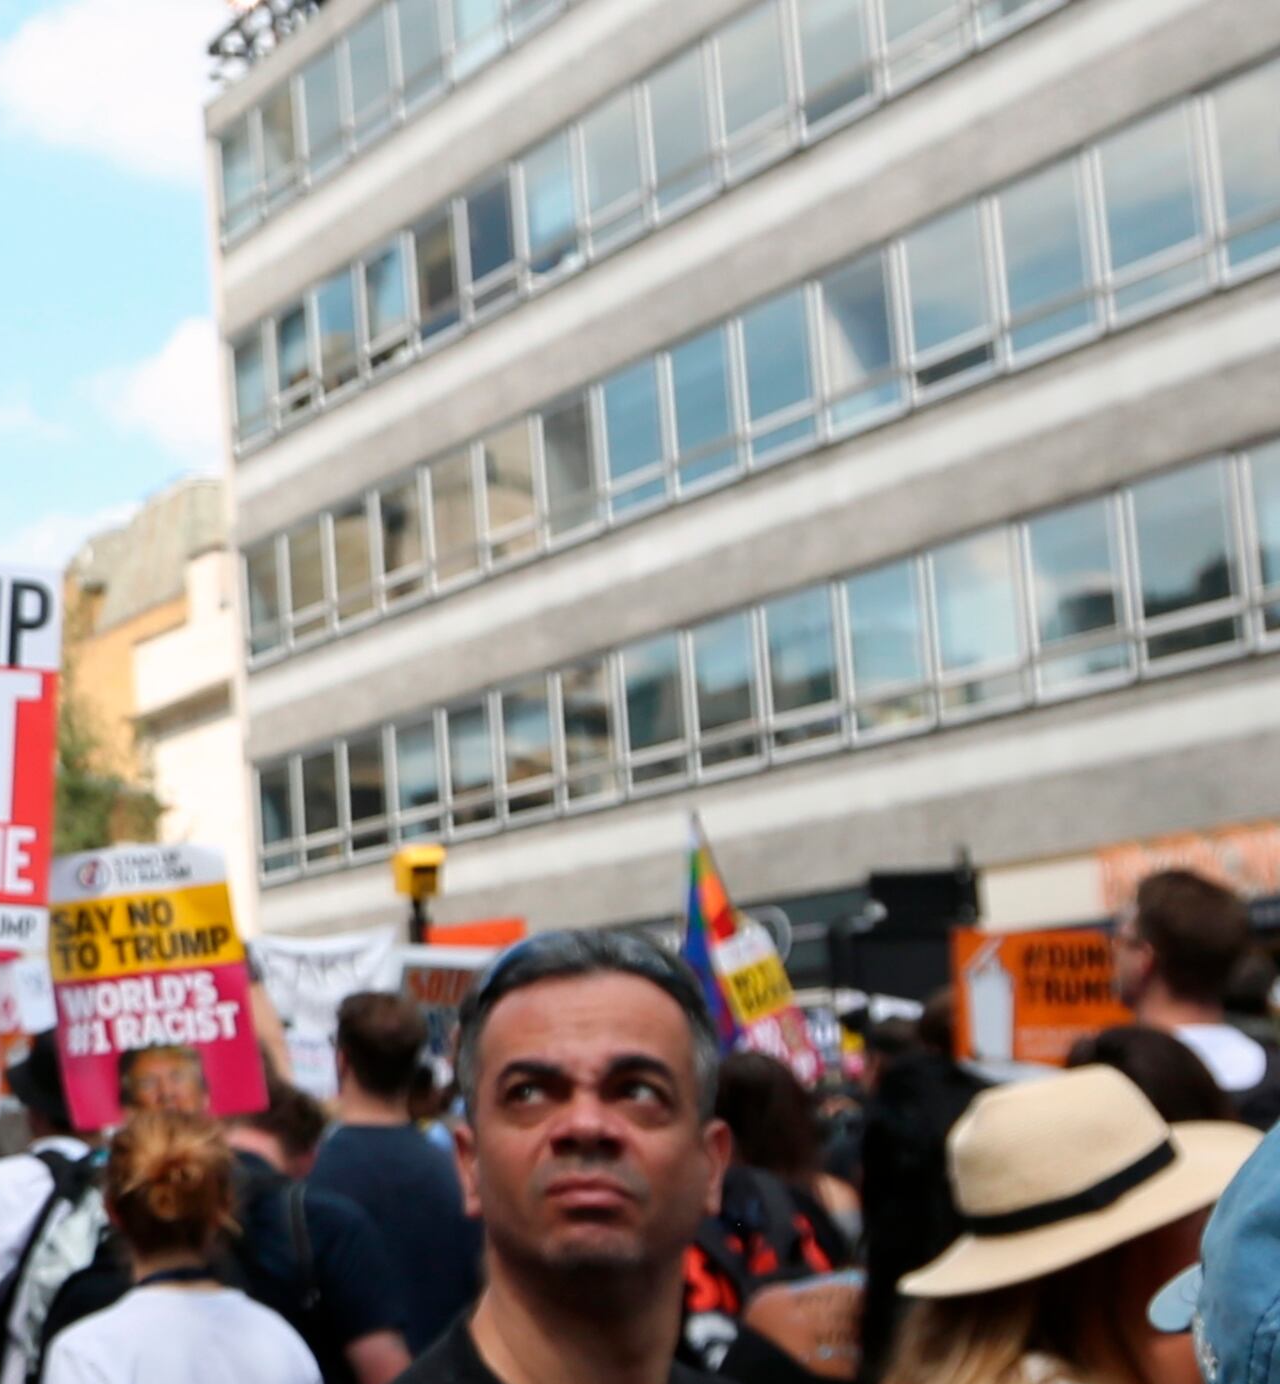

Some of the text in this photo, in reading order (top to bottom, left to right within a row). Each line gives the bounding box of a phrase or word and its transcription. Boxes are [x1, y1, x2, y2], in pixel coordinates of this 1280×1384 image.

[51, 898, 173, 940] SAY NO
[55, 925, 231, 973] TO TRUMP
[62, 969, 218, 1020] WORLD'S
[67, 1001, 240, 1057] #1 RACIST
